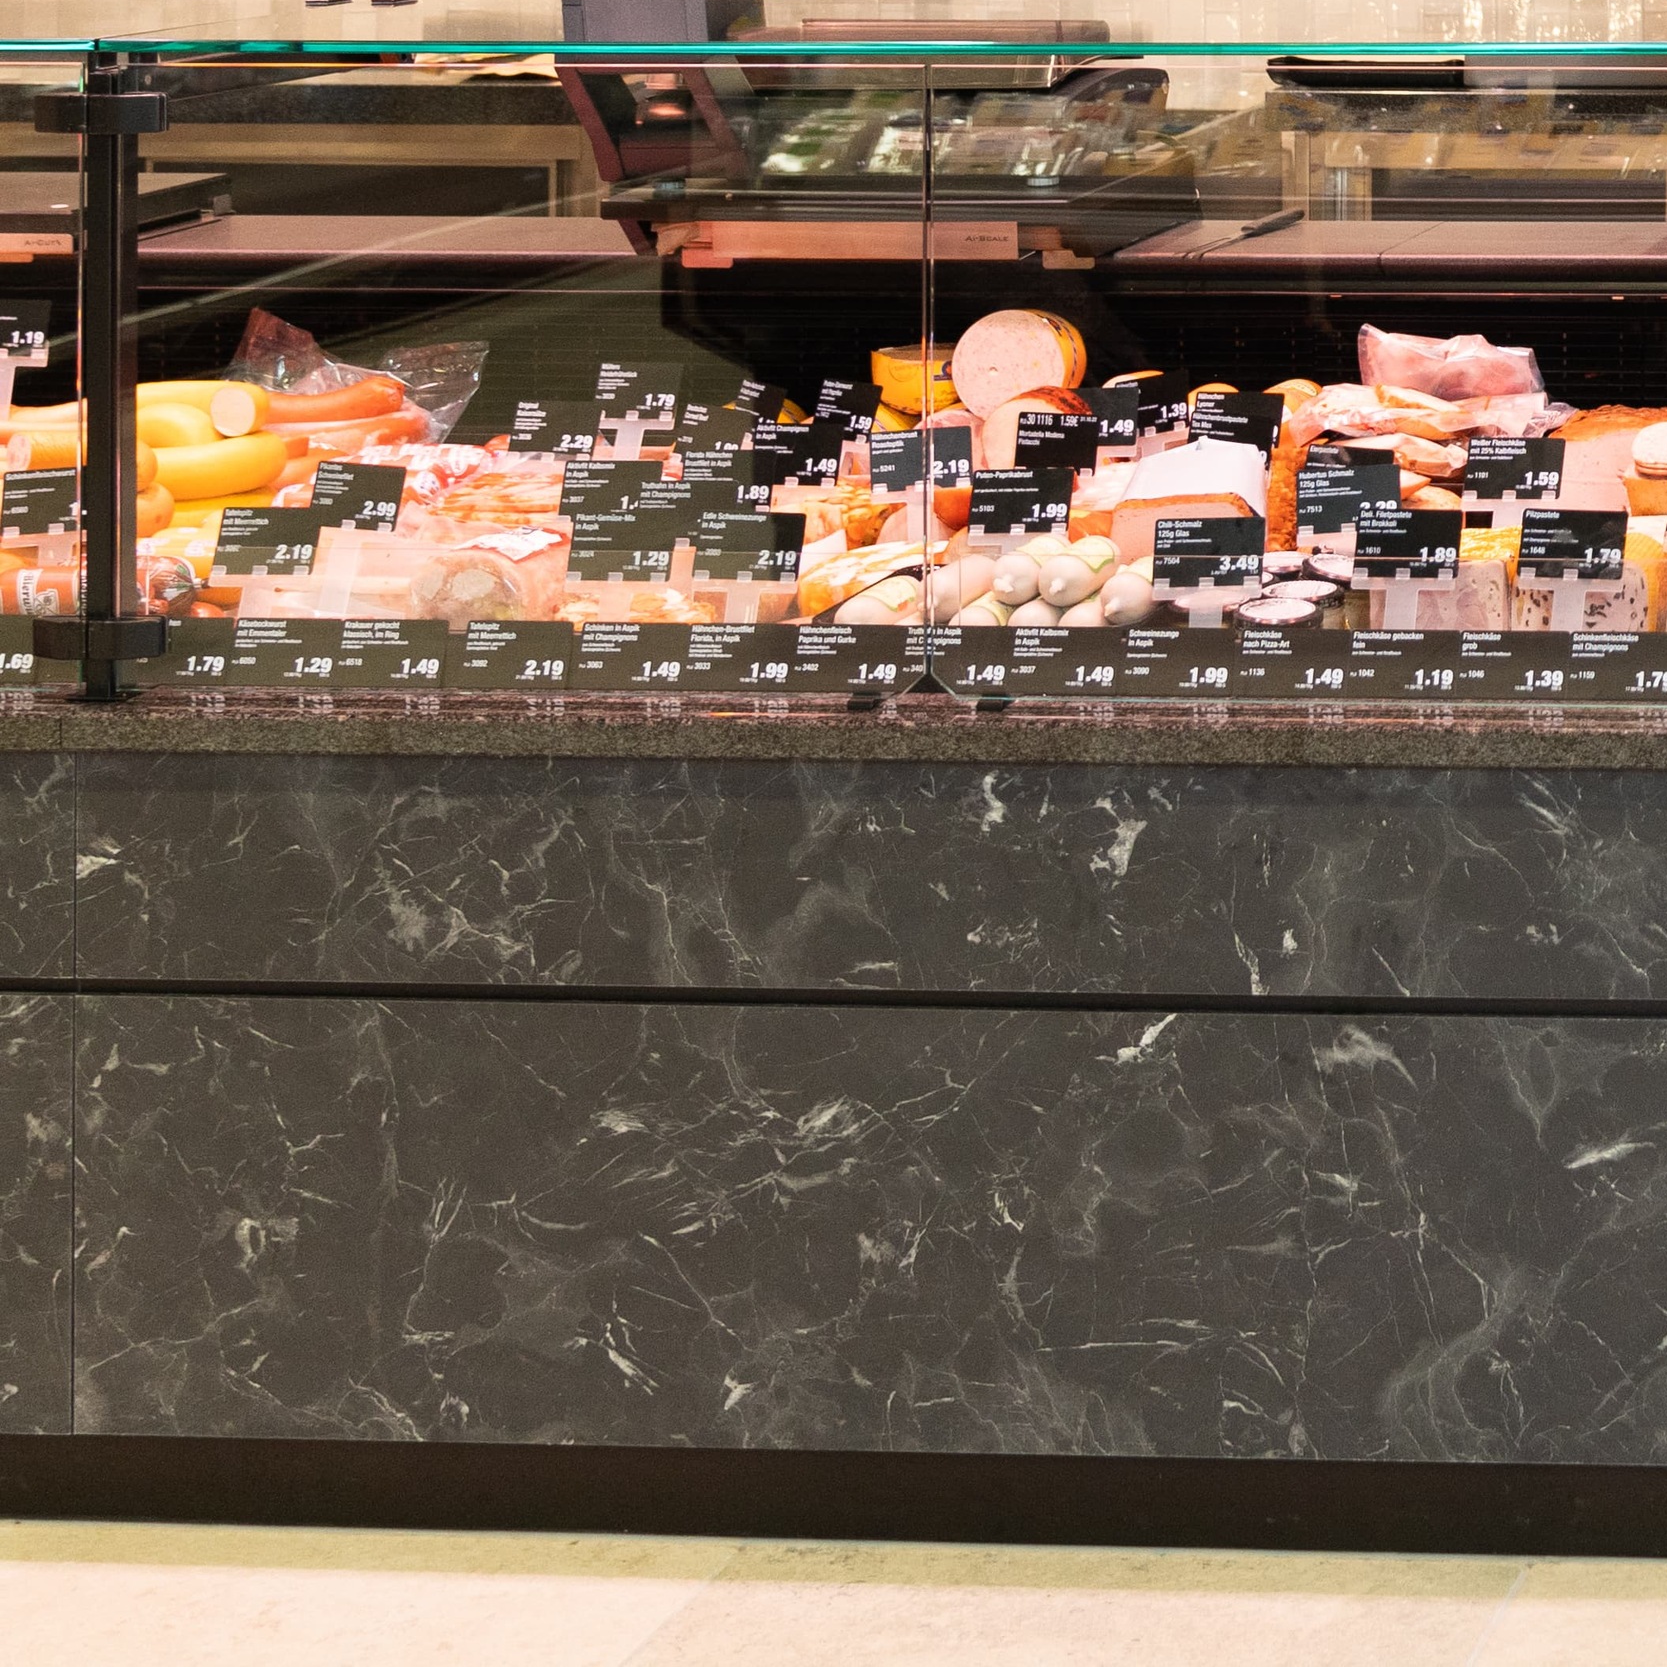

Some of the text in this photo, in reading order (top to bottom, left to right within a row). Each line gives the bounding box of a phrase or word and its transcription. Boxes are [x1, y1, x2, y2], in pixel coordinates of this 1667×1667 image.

[11, 330, 45, 346] 1.19
[645, 394, 675, 407] 1.79
[1160, 402, 1187, 420] 1.39
[850, 416, 873, 430] 1.59
[1100, 419, 1134, 435] 1.49
[561, 434, 593, 449] 2.29
[804, 458, 838, 473] 1.49
[932, 459, 970, 475] 2.19
[1524, 471, 1559, 486] 1.59
[737, 485, 770, 500] 1.89
[363, 501, 397, 517] 2.99
[1032, 504, 1068, 519] 1.99
[275, 544, 313, 560] 2.19
[632, 551, 670, 566] 1.29
[757, 550, 797, 566] 2.19
[1419, 547, 1457, 563] 1.89
[1584, 548, 1621, 564] 1.79
[1219, 555, 1259, 571] 3.49
[187, 656, 225, 671] 1.79
[294, 657, 332, 673] 1.29
[400, 658, 439, 674] 1.49
[524, 660, 564, 676] 2.19
[642, 661, 680, 677] 1.49
[750, 662, 788, 679] 1.99
[859, 663, 896, 680] 1.49
[967, 665, 1004, 681] 1.49
[1075, 666, 1114, 682] 1.49
[1189, 667, 1228, 684] 1.99
[1305, 668, 1343, 685] 1.49
[1414, 669, 1453, 686] 1.19
[1525, 670, 1563, 687] 1.39
